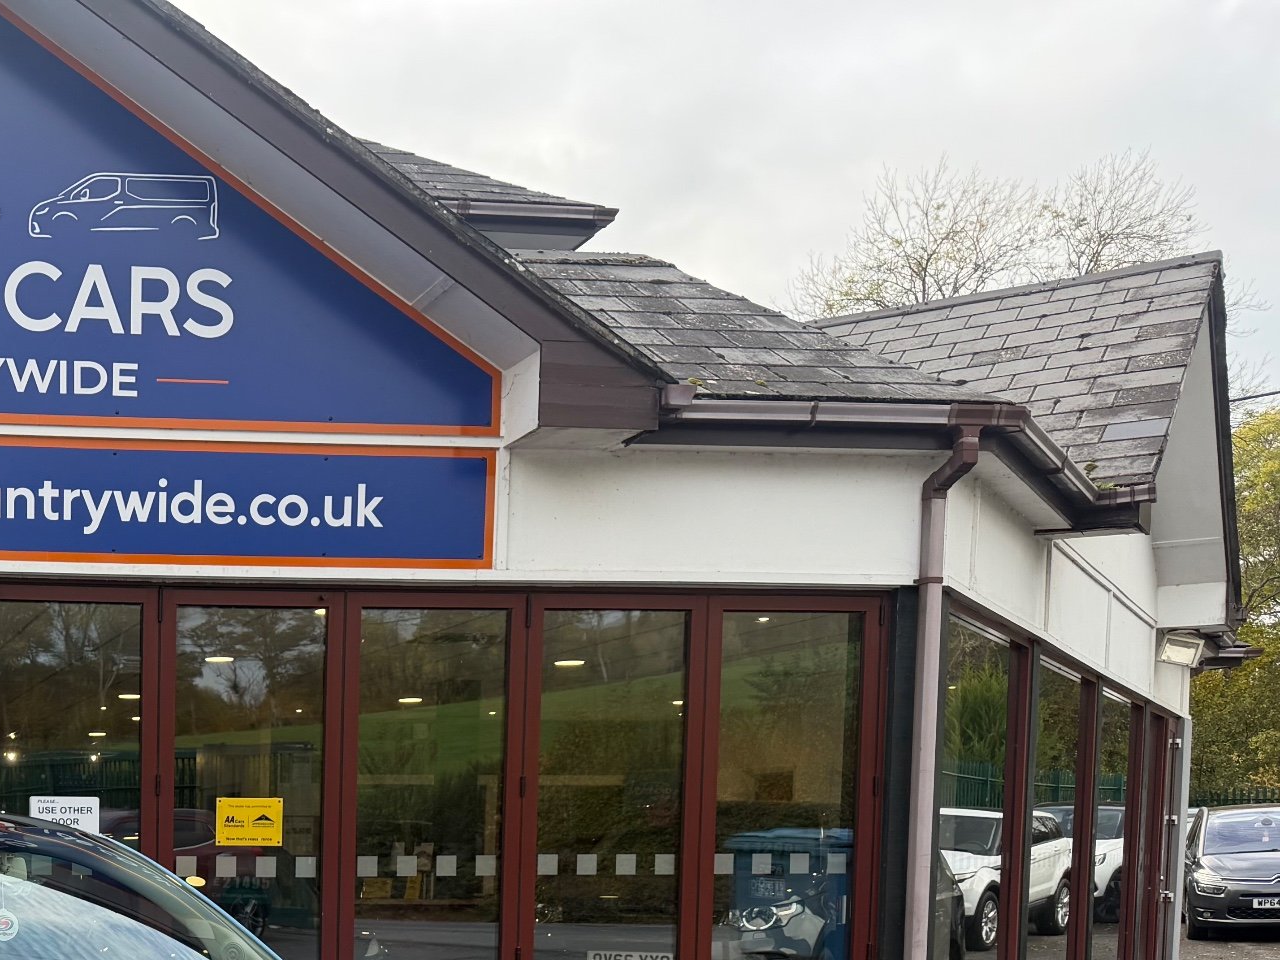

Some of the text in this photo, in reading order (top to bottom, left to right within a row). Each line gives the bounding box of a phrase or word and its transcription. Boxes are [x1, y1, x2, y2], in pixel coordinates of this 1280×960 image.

[4, 260, 234, 339] CARS
[38, 806, 93, 815] USE OTHER
